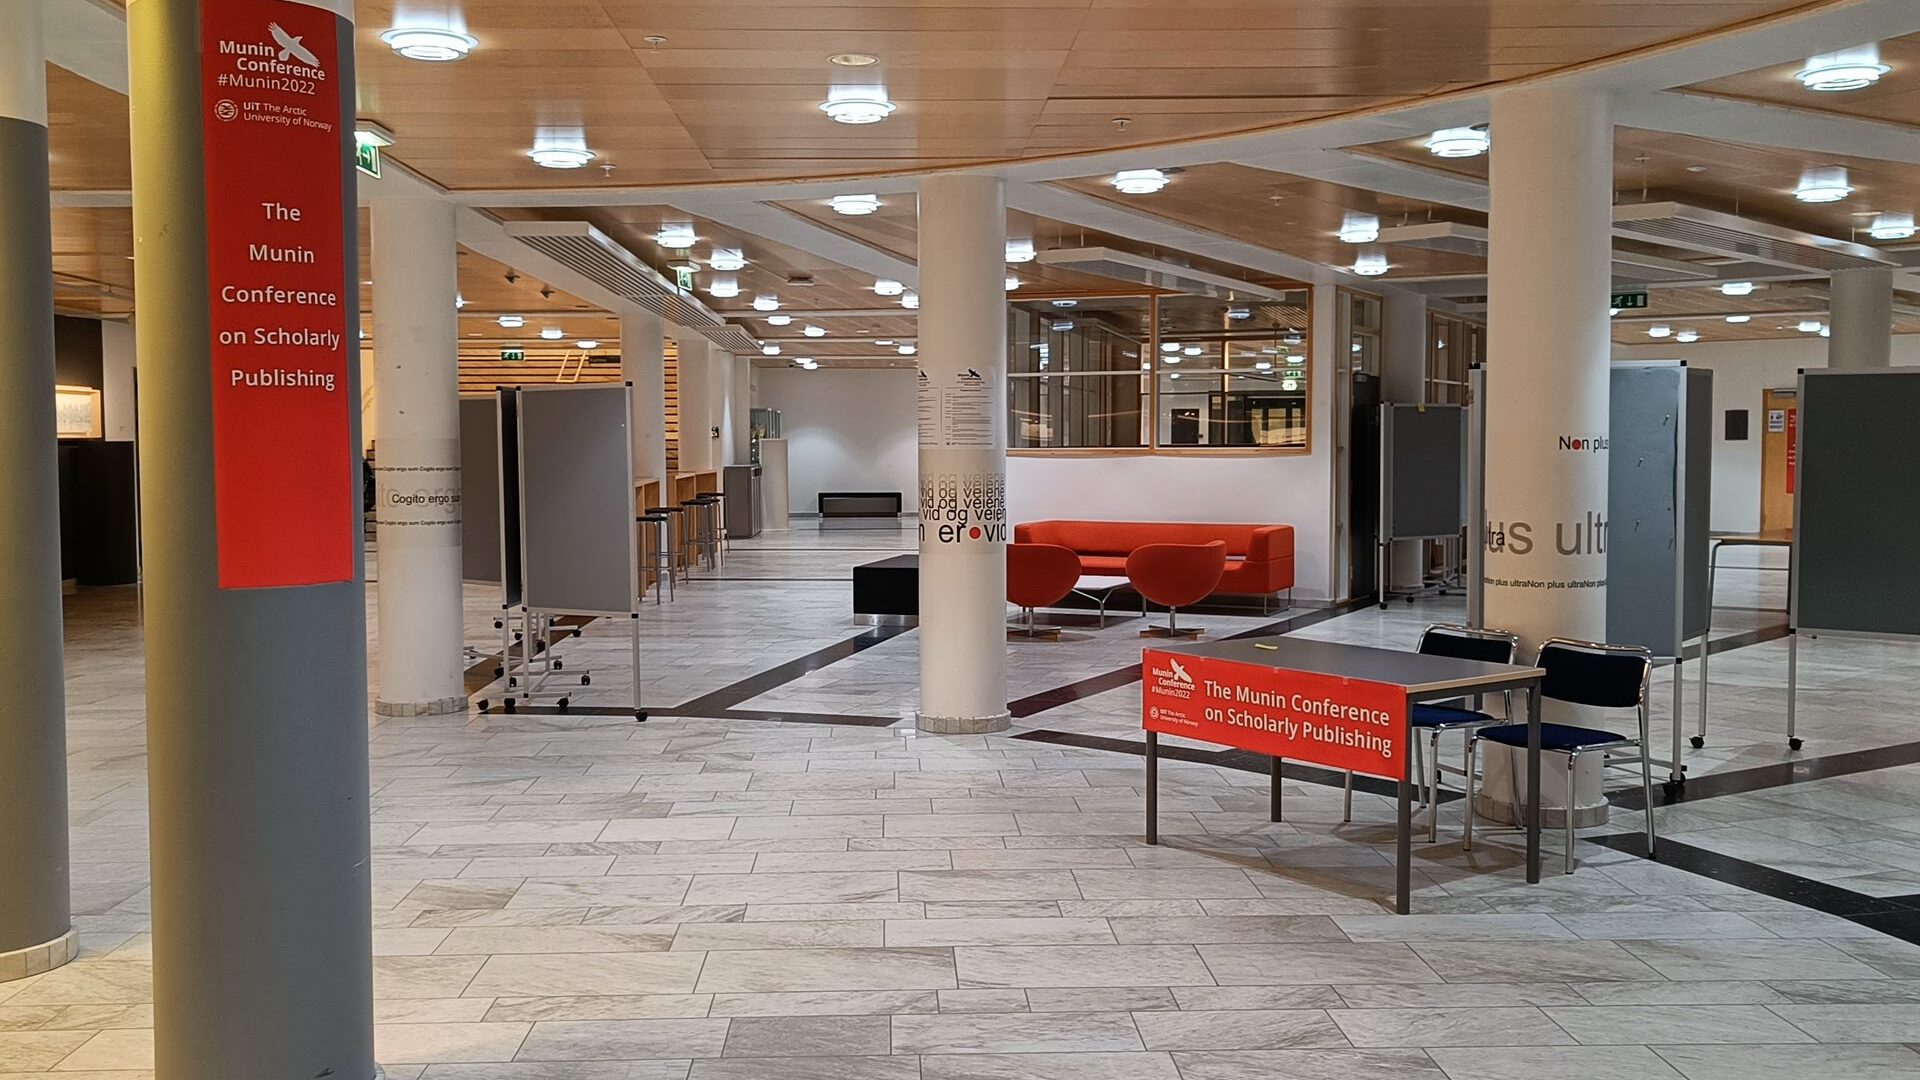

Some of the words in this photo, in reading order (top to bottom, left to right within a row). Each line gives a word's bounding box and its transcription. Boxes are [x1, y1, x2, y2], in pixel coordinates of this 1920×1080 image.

[220, 41, 274, 57] Munin
[237, 58, 325, 81] Conference
[218, 74, 315, 95] #Munin2022
[243, 102, 260, 111] UiT
[263, 103, 280, 113] The
[283, 105, 307, 116] Arctic
[244, 113, 291, 126] University
[293, 117, 301, 125] of
[304, 118, 332, 132] Norway
[262, 202, 301, 222] The
[249, 244, 315, 264] Munin
[221, 286, 337, 306] Conference
[219, 331, 246, 344] on
[254, 327, 340, 351] Scholarly
[231, 369, 335, 391] Publishing
[392, 494, 425, 506] Cogito
[428, 496, 449, 506] ergo
[1547, 580, 1565, 590] plus
[1152, 667, 1173, 678] Munin
[1151, 686, 1190, 699] #Munin2022
[1158, 677, 1195, 691] Conference
[1204, 680, 1231, 700] The
[1236, 685, 1286, 709] Munin
[1292, 694, 1390, 726] Conference
[1205, 707, 1223, 723] on
[1228, 709, 1298, 740] Scholarly
[1303, 721, 1392, 758] Publishing
